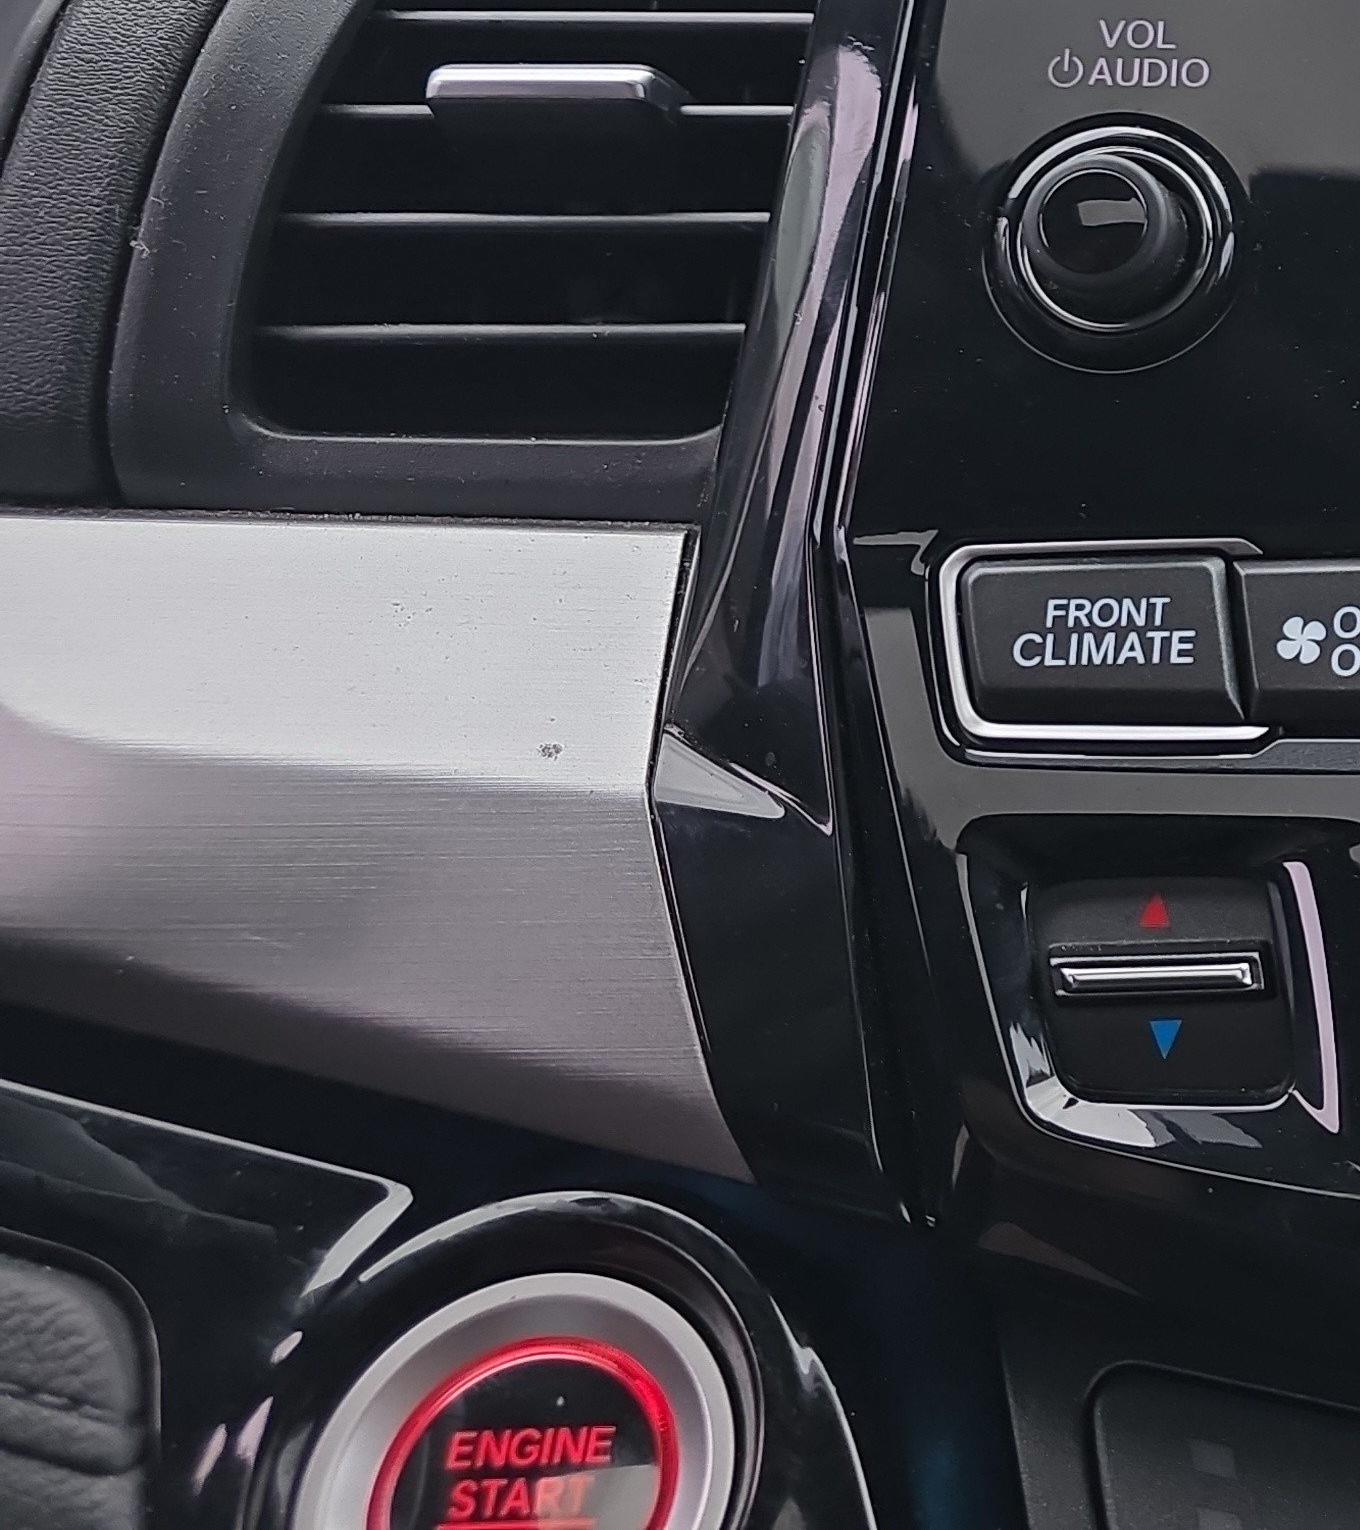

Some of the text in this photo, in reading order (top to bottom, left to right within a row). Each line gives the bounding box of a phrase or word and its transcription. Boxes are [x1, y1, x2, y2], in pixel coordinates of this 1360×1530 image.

[1100, 19, 1177, 50] VOL
[1087, 57, 1210, 88] AUDIO
[1044, 597, 1171, 630] FRONT
[1012, 630, 1197, 668] CLIMATE
[446, 1425, 617, 1470] ENGINE
[450, 1477, 593, 1519] START
